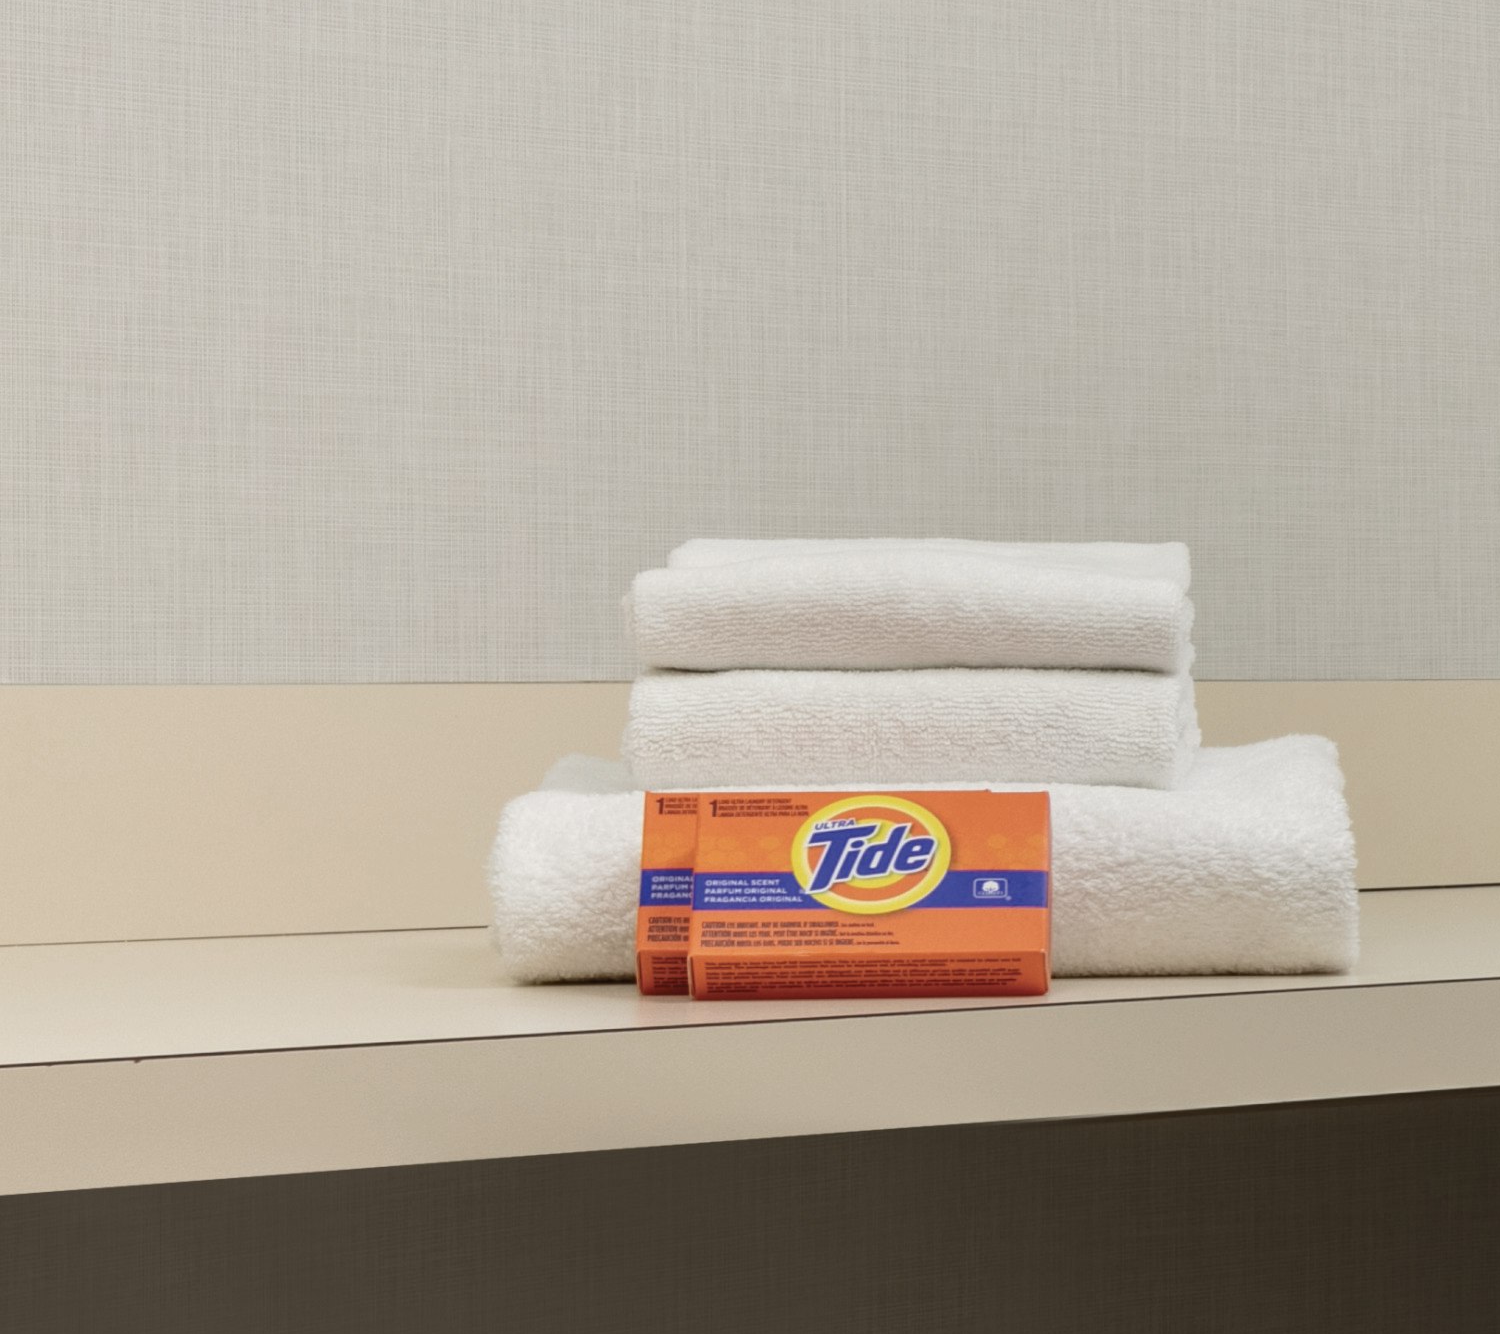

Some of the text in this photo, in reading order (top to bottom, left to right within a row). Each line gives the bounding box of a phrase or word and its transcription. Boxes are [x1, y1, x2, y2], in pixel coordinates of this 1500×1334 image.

[656, 797, 665, 815] 1
[709, 799, 718, 817] 1
[815, 819, 856, 831] ULTRA
[807, 824, 936, 892] Tide
